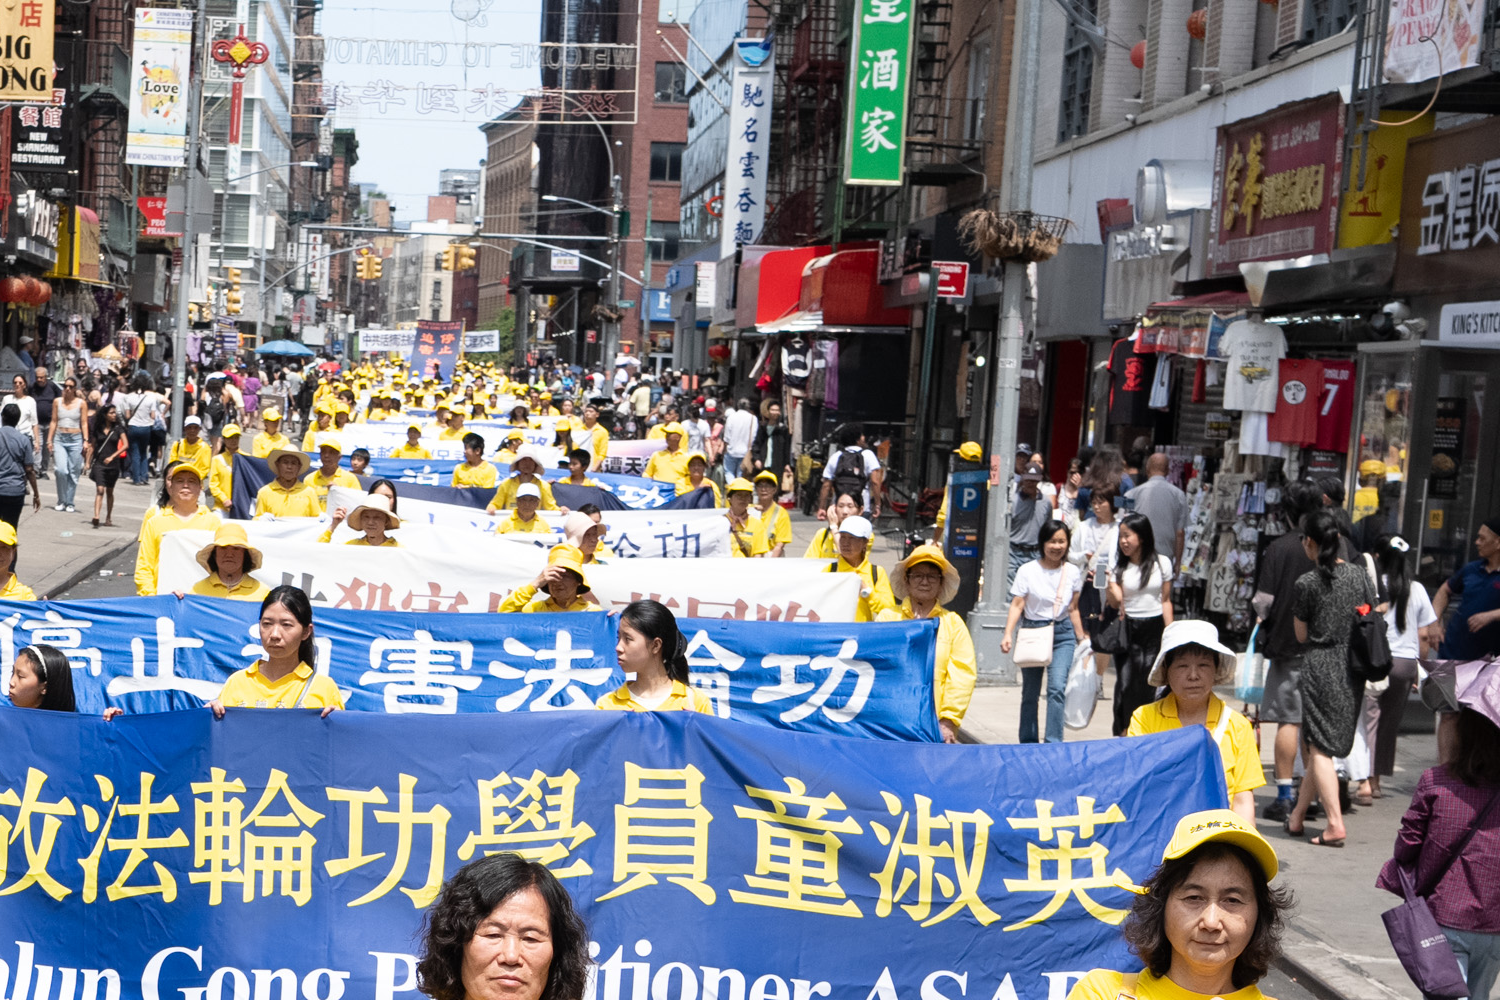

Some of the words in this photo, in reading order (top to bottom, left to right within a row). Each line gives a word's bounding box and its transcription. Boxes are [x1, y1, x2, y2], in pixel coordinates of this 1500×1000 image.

[144, 80, 179, 94] Love
[19, 106, 62, 128] 餐館
[29, 132, 48, 141] NEW
[17, 143, 59, 153] SHANGHAI
[12, 154, 66, 165] RESTAURANT
[1451, 313, 1479, 334] KING'S
[1321, 383, 1340, 416] 7
[963, 487, 977, 508] P
